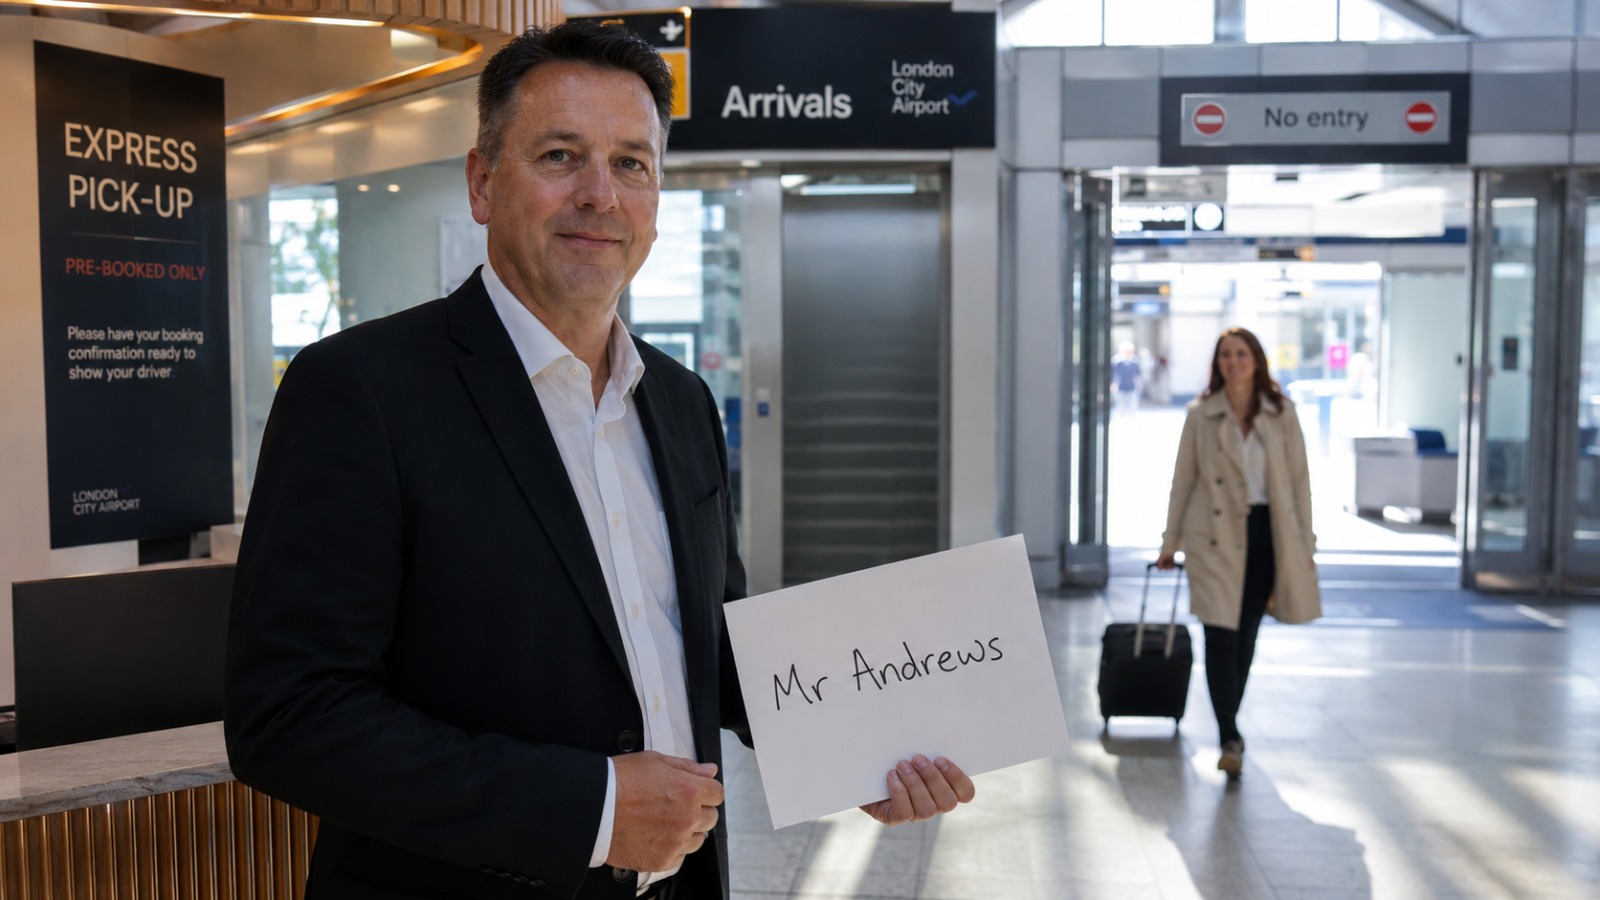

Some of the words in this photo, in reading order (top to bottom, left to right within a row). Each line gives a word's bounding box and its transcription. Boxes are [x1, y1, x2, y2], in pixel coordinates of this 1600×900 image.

[891, 59, 954, 78] London
[891, 78, 925, 99] City
[721, 84, 853, 119] Arrivals
[891, 97, 950, 117] Airport
[1264, 107, 1298, 128] No
[1307, 107, 1370, 133] entry
[65, 122, 198, 173] EXPRESS
[69, 174, 193, 219] PICK-UP
[65, 257, 165, 279] PRE-BOOKED
[168, 264, 206, 281] ONLY
[67, 326, 105, 340] Please
[107, 326, 134, 341] have
[136, 330, 160, 344] your
[162, 328, 204, 345] booking
[68, 345, 145, 360] confirmation
[147, 346, 181, 362] ready
[184, 347, 196, 360] to
[69, 365, 103, 380] show
[106, 367, 135, 382] your
[73, 488, 118, 503] LONDON
[72, 502, 97, 516] CITY
[99, 498, 140, 513] AIRPORT
[772, 663, 828, 711] Mr
[852, 636, 1004, 691] Andrews
